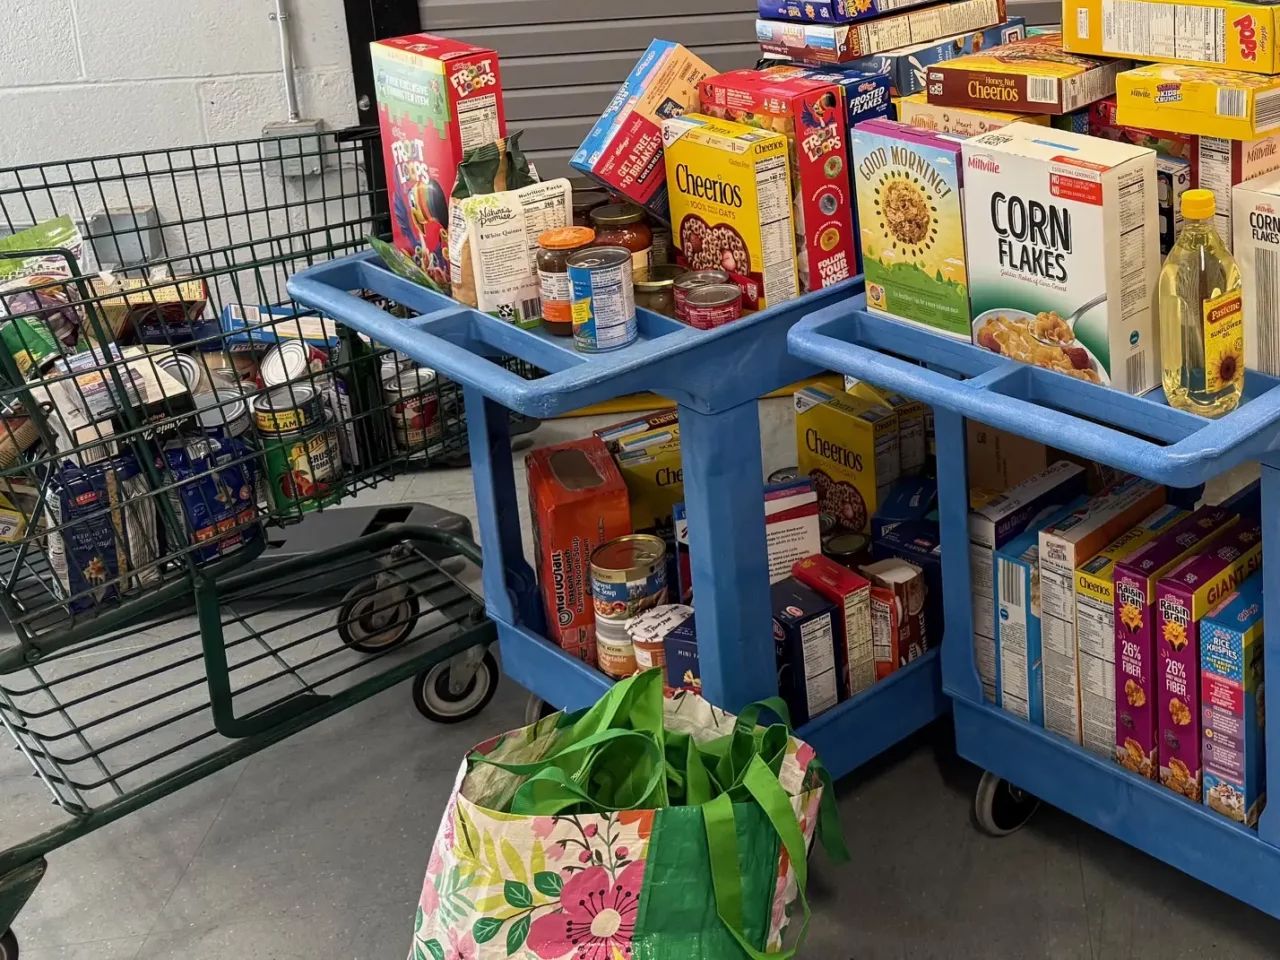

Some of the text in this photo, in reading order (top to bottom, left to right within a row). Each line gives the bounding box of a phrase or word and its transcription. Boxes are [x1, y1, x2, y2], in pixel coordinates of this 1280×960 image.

[1233, 14, 1258, 63] POPS
[450, 60, 492, 88] FROOT
[986, 77, 1015, 87] Honey Nut
[457, 72, 496, 97] LOOPS
[968, 81, 1019, 102] Cheerios
[1159, 89, 1180, 97] KIDS
[850, 87, 884, 108] FROSTED
[1130, 89, 1150, 99] Millville
[1154, 95, 1182, 103] KRUNCH
[853, 97, 882, 115] FLAKES
[911, 116, 938, 130] Millville
[956, 119, 972, 128] Heart
[754, 141, 784, 155] Cheerios
[801, 123, 838, 155] FROOT
[391, 139, 424, 163] FROOT
[618, 159, 630, 176] GET
[631, 151, 638, 160] A
[636, 133, 652, 154] FREE
[807, 136, 841, 162] LOOPS
[1247, 140, 1277, 164] Millville
[620, 131, 663, 188] $10 BREAKFAST
[967, 156, 1000, 174] Millville
[398, 161, 429, 183] LOOPS
[859, 147, 888, 182] GOOD
[890, 145, 952, 199] MORNING!
[1052, 176, 1060, 184] NO
[519, 184, 563, 199] Nutrition Facts
[676, 164, 742, 208] Cheerios
[1052, 187, 1060, 195] NO
[480, 207, 512, 218] Nature's
[690, 201, 736, 220] 100% OATS
[1255, 205, 1275, 214] Millville
[991, 191, 1072, 254] CORN
[1250, 212, 1280, 234] CORN
[502, 228, 522, 236] Quinoa
[1253, 229, 1280, 244] FLAKES
[818, 251, 845, 268] FOLLOW
[819, 259, 847, 278] YOUR
[998, 239, 1068, 283] FLAKES
[822, 269, 850, 287] NOSE
[1212, 302, 1240, 320] Pastene
[1211, 320, 1241, 338] SUNFLOWER
[806, 428, 863, 472] Cheerios
[565, 549, 574, 607] Instant Lunch
[575, 560, 583, 590] Noodle
[1080, 577, 1110, 596] Cheerios
[1117, 582, 1145, 601] Raisin
[1207, 564, 1244, 605] GIANT
[1120, 593, 1143, 609] Bran
[1160, 599, 1188, 617] Raisin
[1163, 610, 1187, 627] Bran
[1122, 640, 1141, 660] 26%
[1206, 644, 1238, 660] KRISPIES
[1213, 638, 1231, 651] RICE
[1122, 661, 1142, 678] FIBER
[1166, 658, 1185, 678] 26%
[1166, 679, 1186, 696] FIBER
